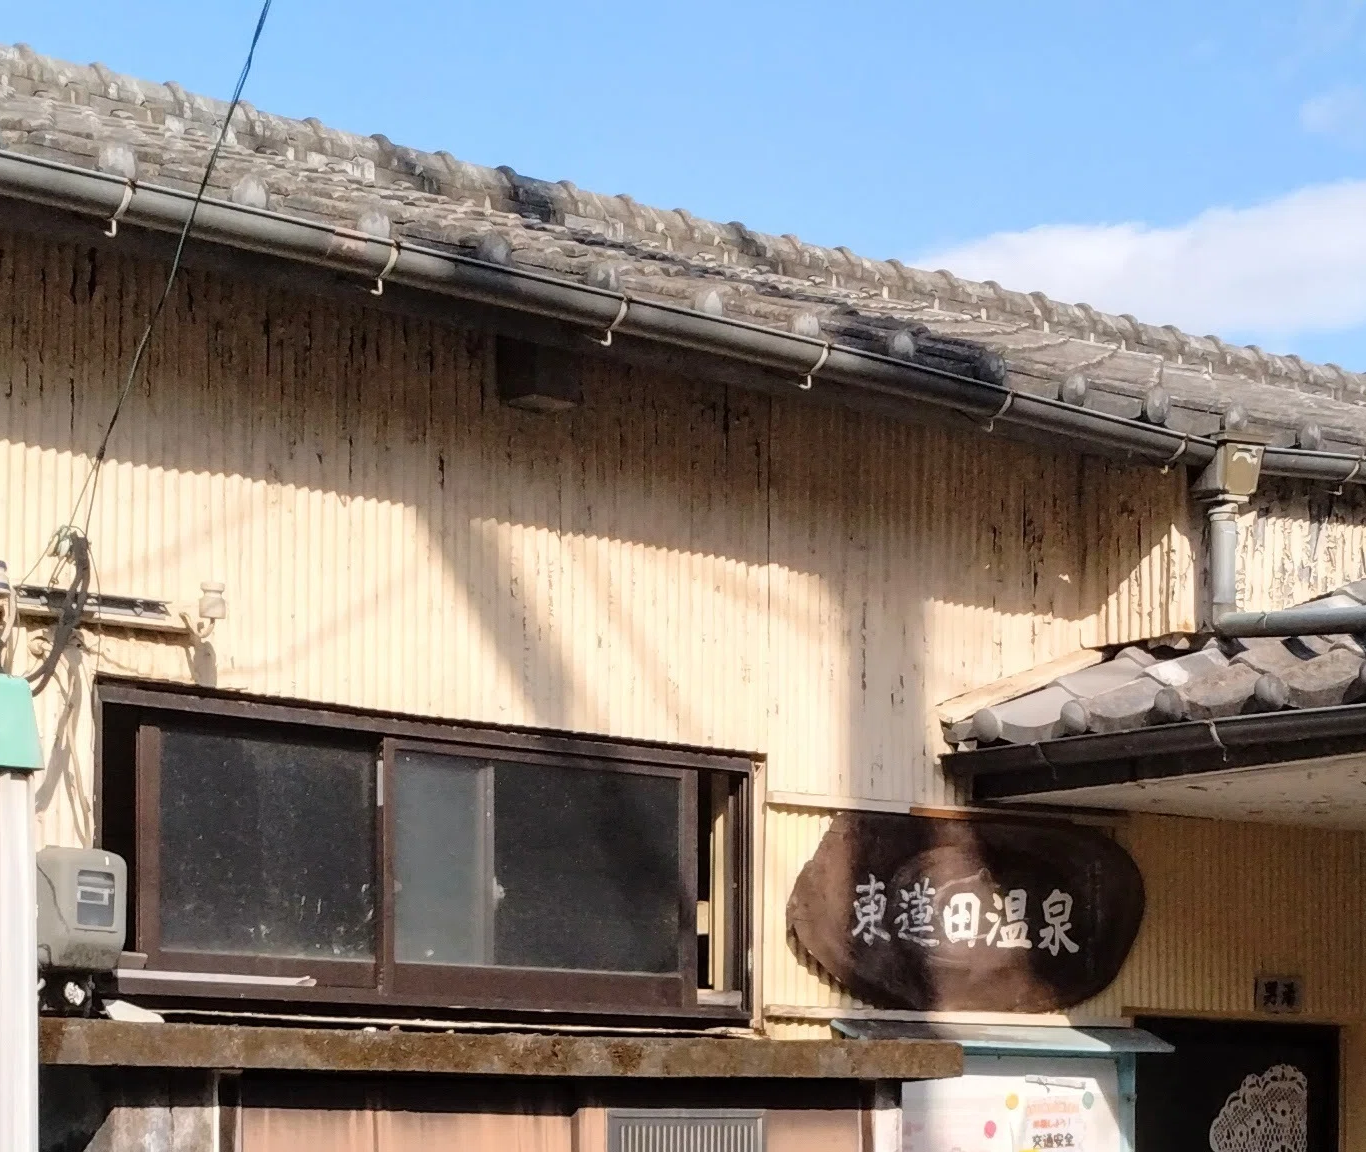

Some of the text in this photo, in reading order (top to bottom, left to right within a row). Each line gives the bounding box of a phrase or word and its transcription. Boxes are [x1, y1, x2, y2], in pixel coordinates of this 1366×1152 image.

[851, 874, 1080, 956] 東蓮田温泉
[1264, 981, 1296, 1008] 男湯
[1032, 1132, 1075, 1149] 交通安全
